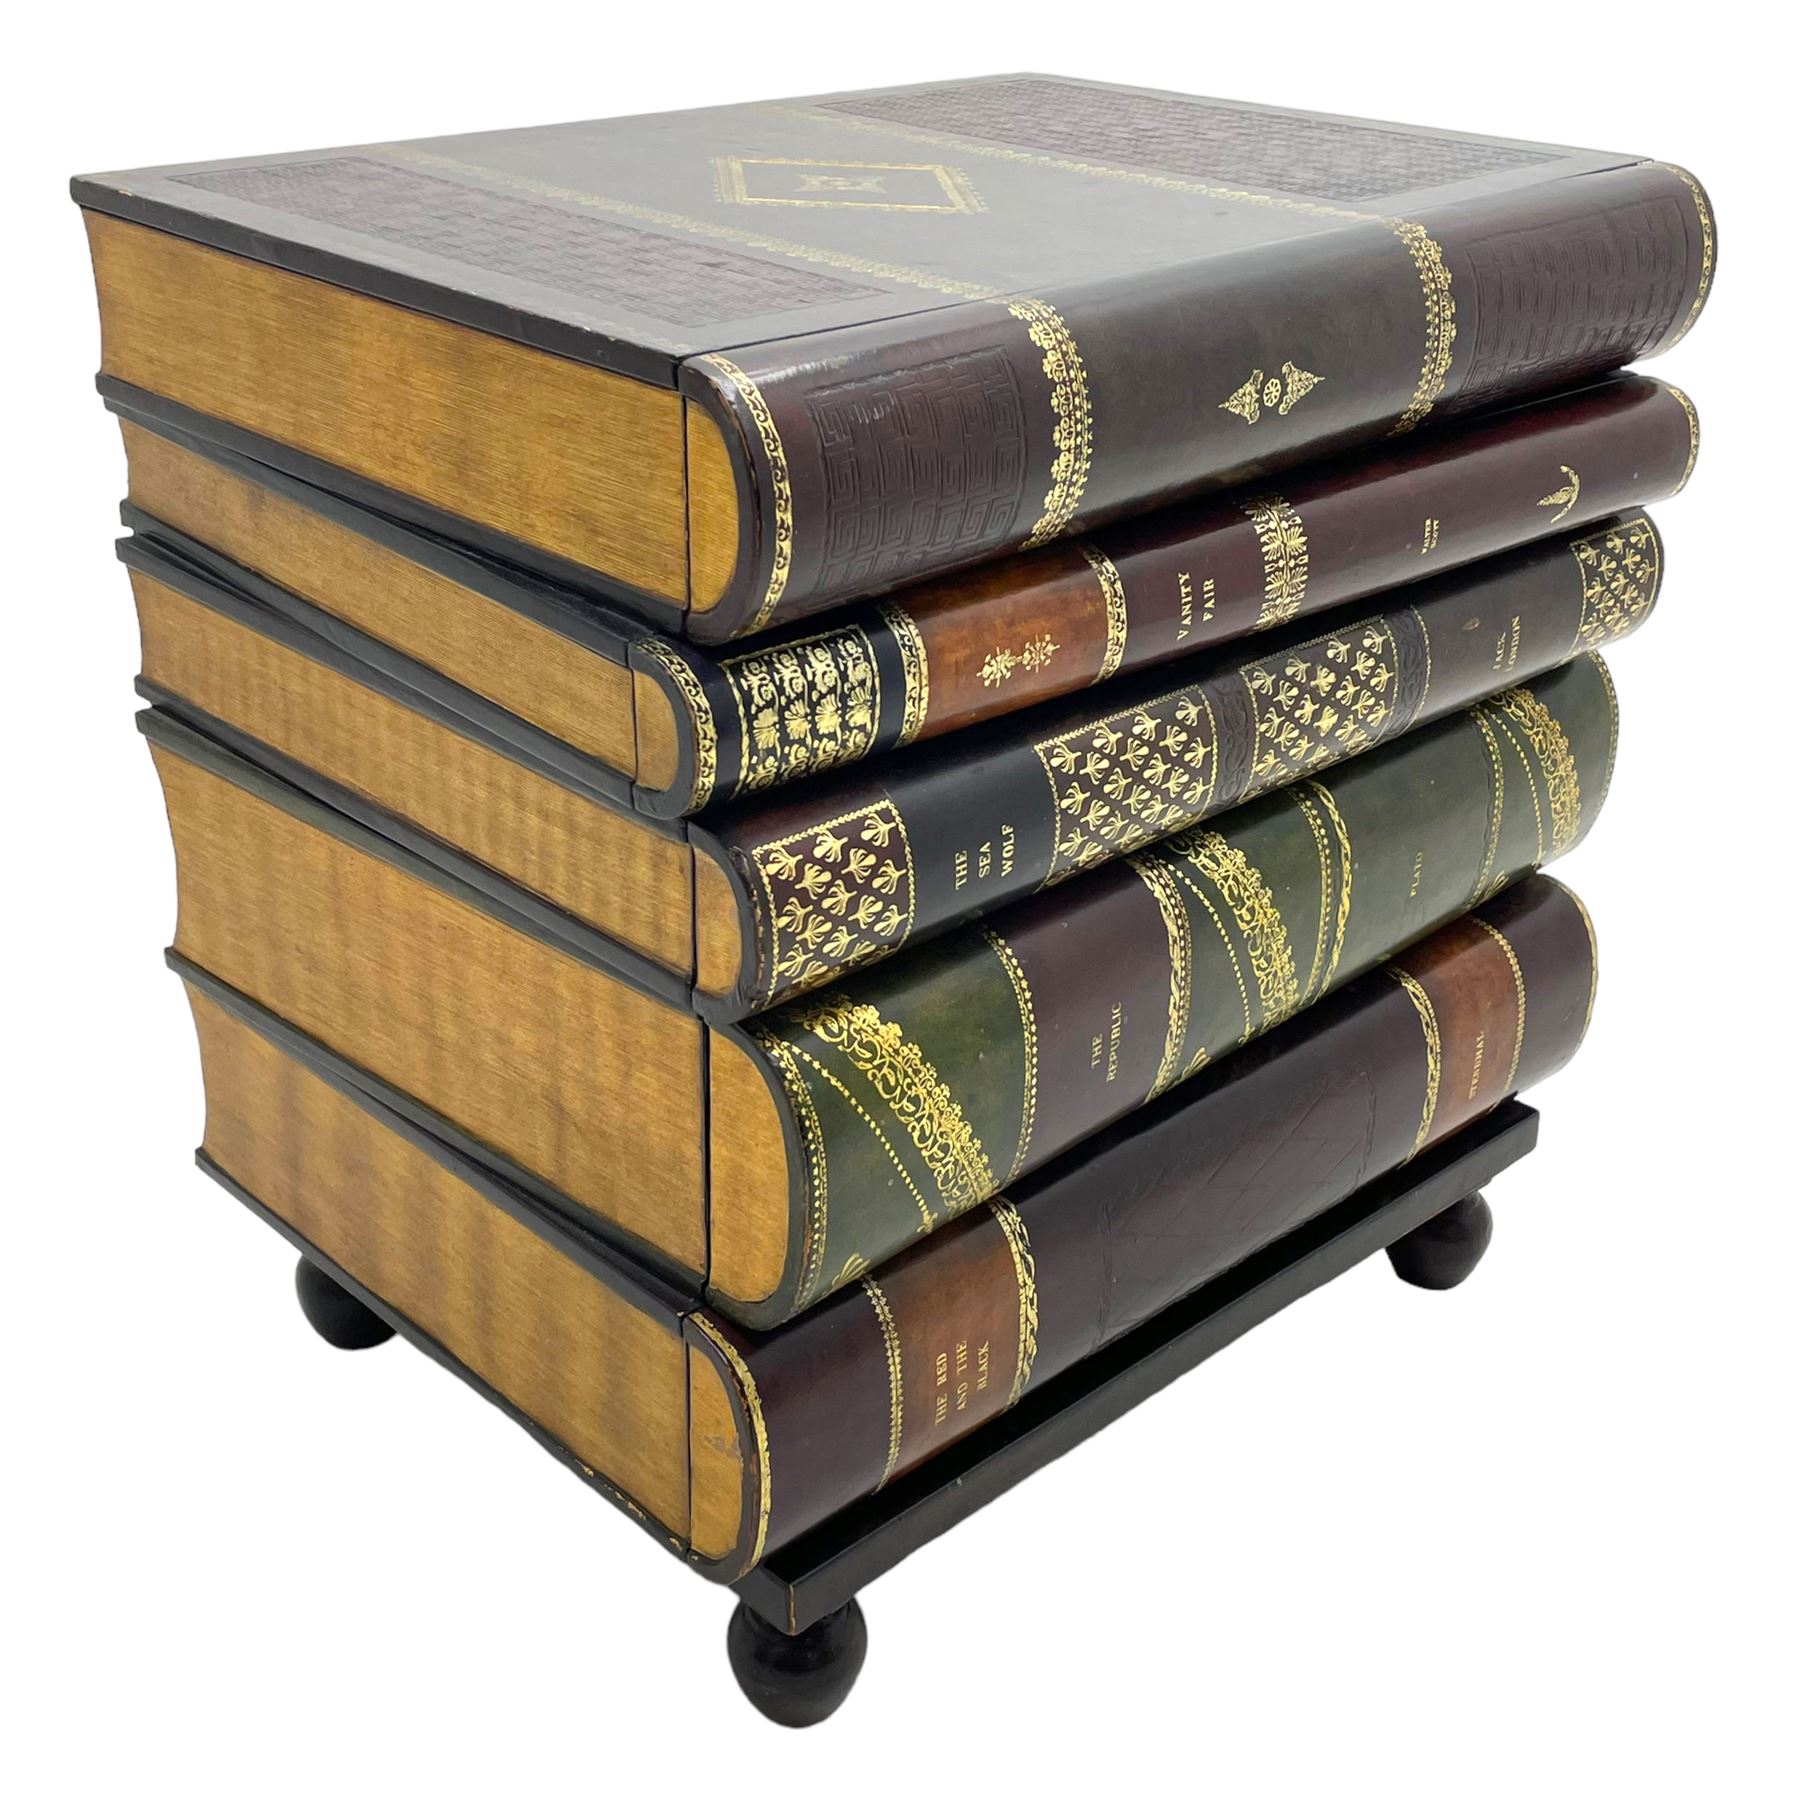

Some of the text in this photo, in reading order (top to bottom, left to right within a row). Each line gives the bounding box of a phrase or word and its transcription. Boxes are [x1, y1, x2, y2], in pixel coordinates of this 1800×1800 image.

[1177, 572, 1192, 640] VANITY
[1203, 579, 1215, 621] FAIR
[1493, 631, 1506, 670] JACK
[1505, 616, 1520, 671] LONDON
[955, 850, 967, 890] THE
[979, 841, 991, 878] SEA
[1001, 824, 1014, 877] WOLF
[1410, 852, 1422, 897] PLATO
[1091, 1033, 1102, 1069] THE
[1106, 1002, 1121, 1082] REPUBLIC
[935, 1352, 947, 1426] THE RED
[956, 1340, 968, 1410] AND THE
[977, 1340, 989, 1391] BLACK
